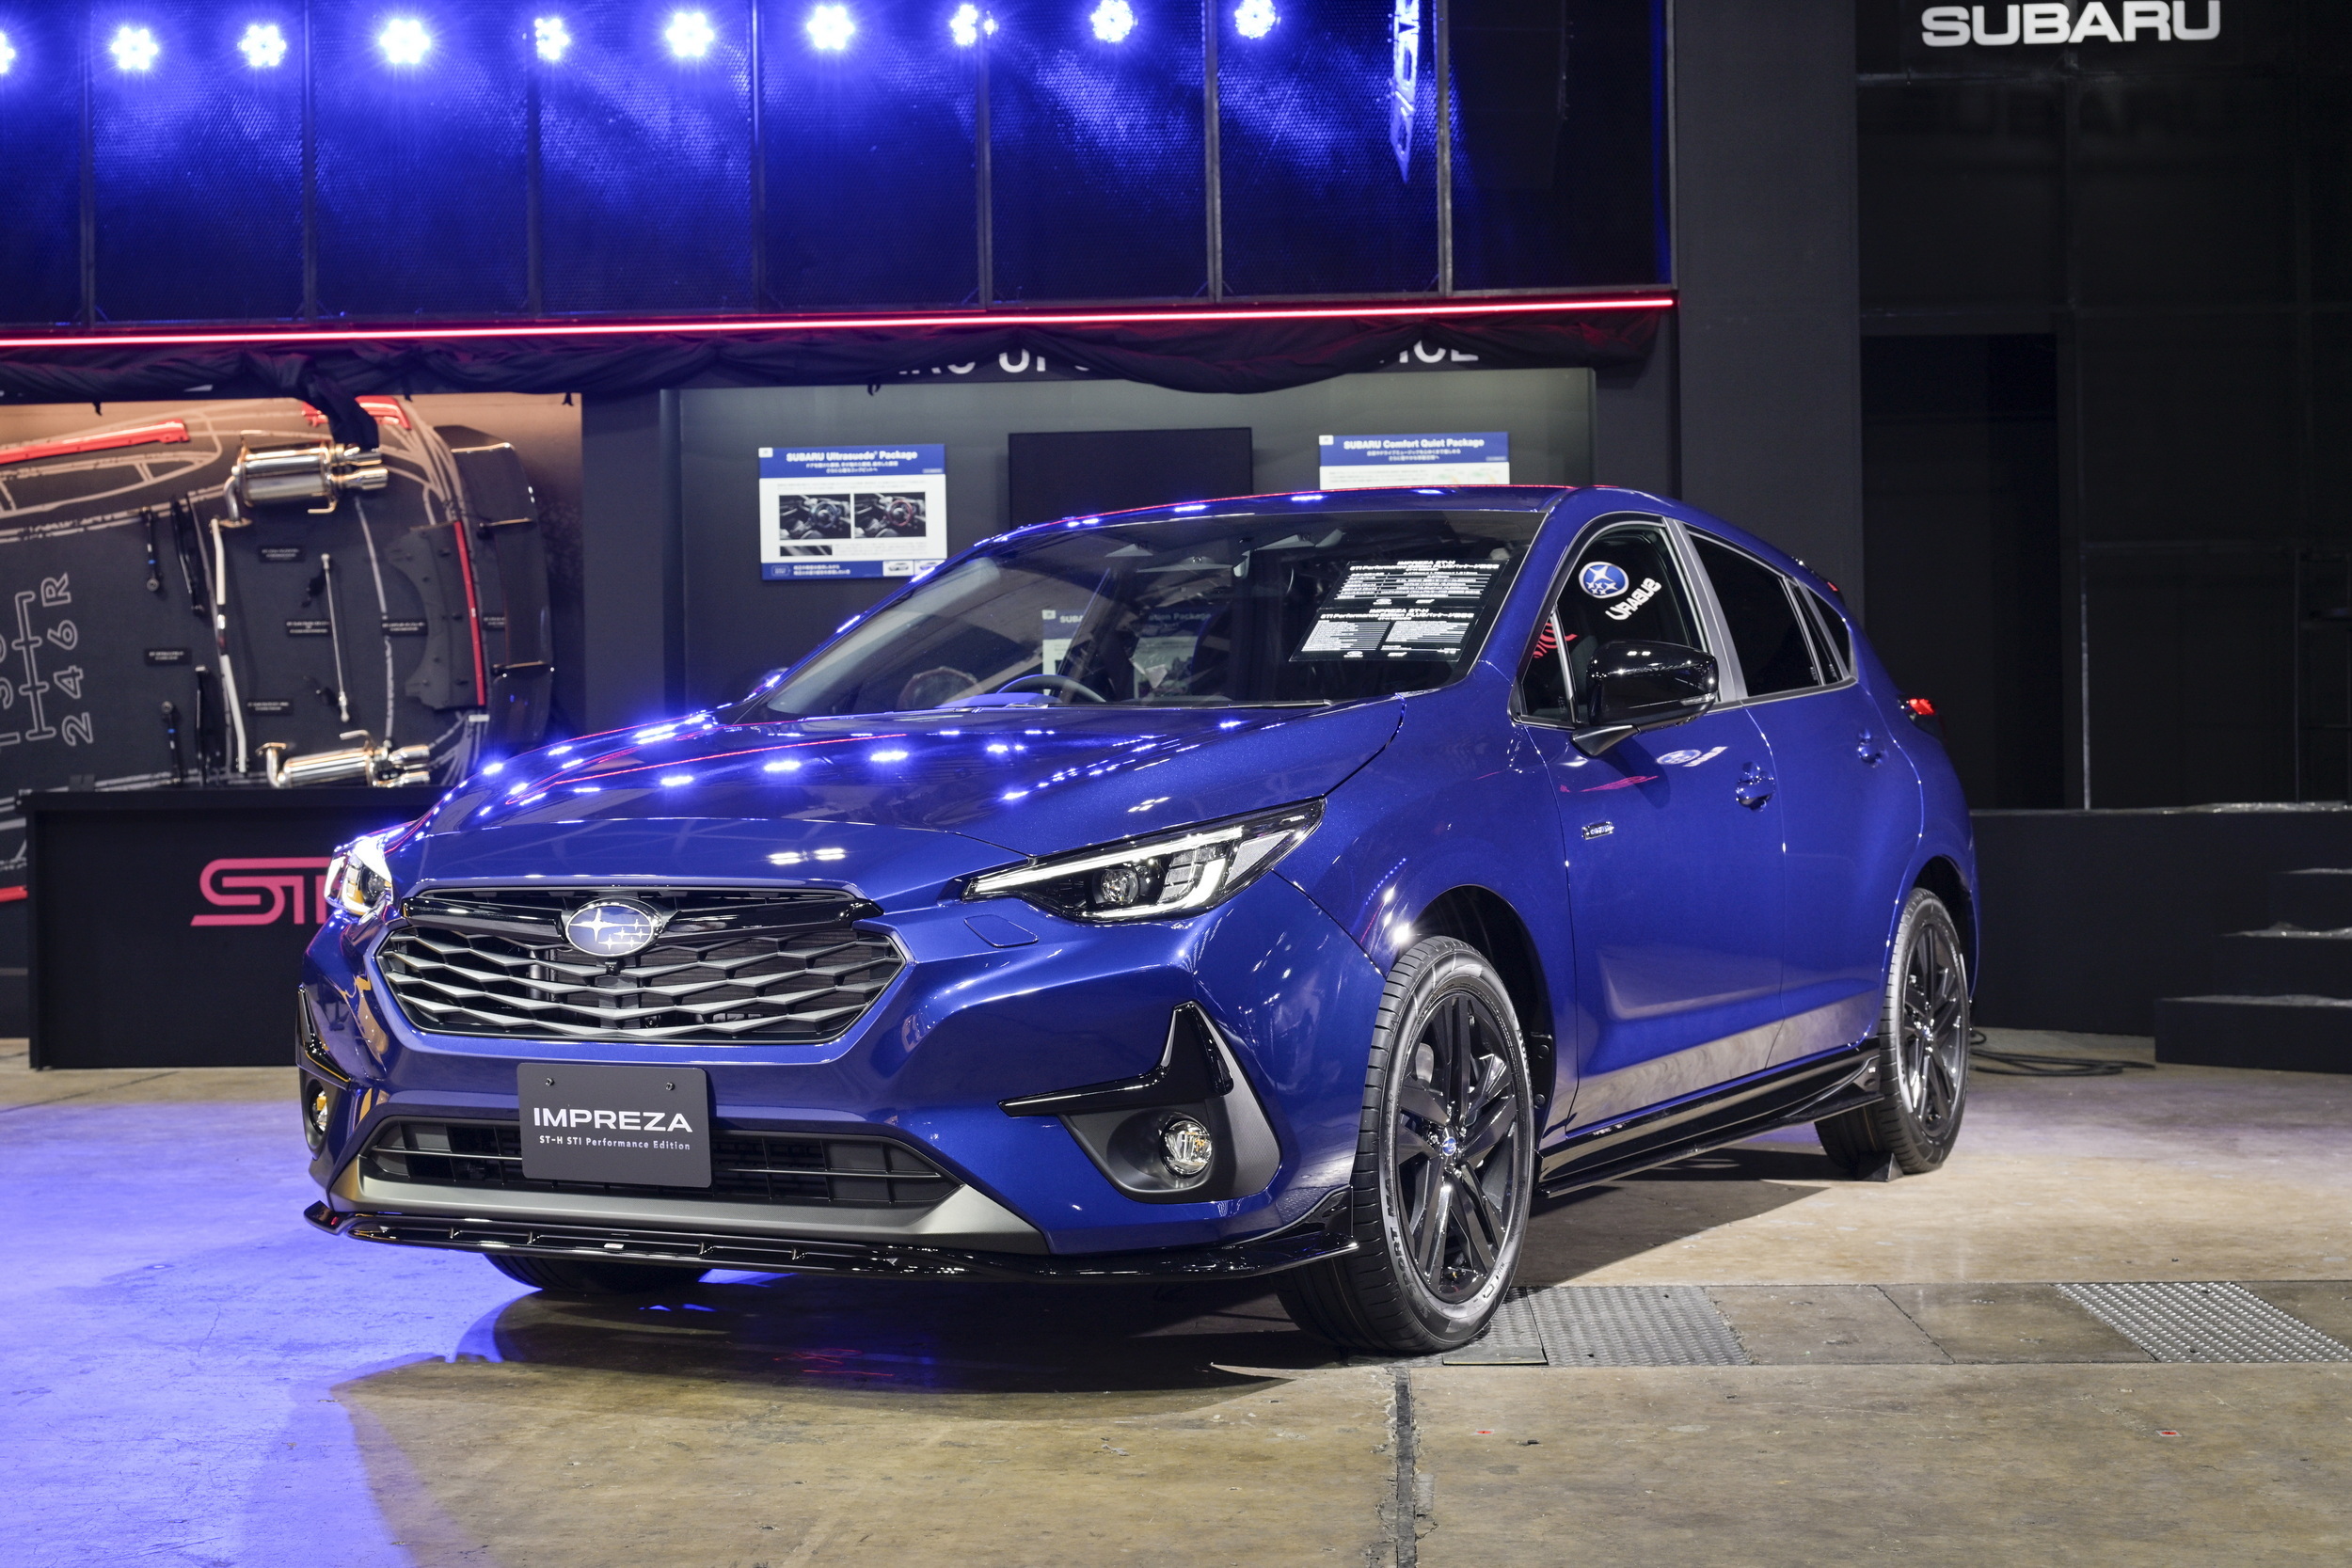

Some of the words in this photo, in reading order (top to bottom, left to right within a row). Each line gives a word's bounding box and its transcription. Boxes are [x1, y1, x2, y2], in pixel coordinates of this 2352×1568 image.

[1921, 0, 2221, 47] SUBARU
[787, 451, 825, 462] SUBARU
[879, 451, 918, 461] Package
[1343, 440, 1381, 450] SUBARU
[1382, 439, 1420, 449] Comfort
[1420, 438, 1445, 448] Quiet
[1446, 437, 1485, 448] Package
[40, 572, 72, 607] R
[47, 620, 78, 650] 6
[53, 665, 85, 699] 4
[61, 712, 94, 747] 2
[533, 1107, 693, 1133] IMPREZA
[539, 1135, 564, 1145] ST-H
[566, 1136, 582, 1146] STI
[585, 1137, 649, 1148] Performance
[653, 1140, 691, 1150] Edition
